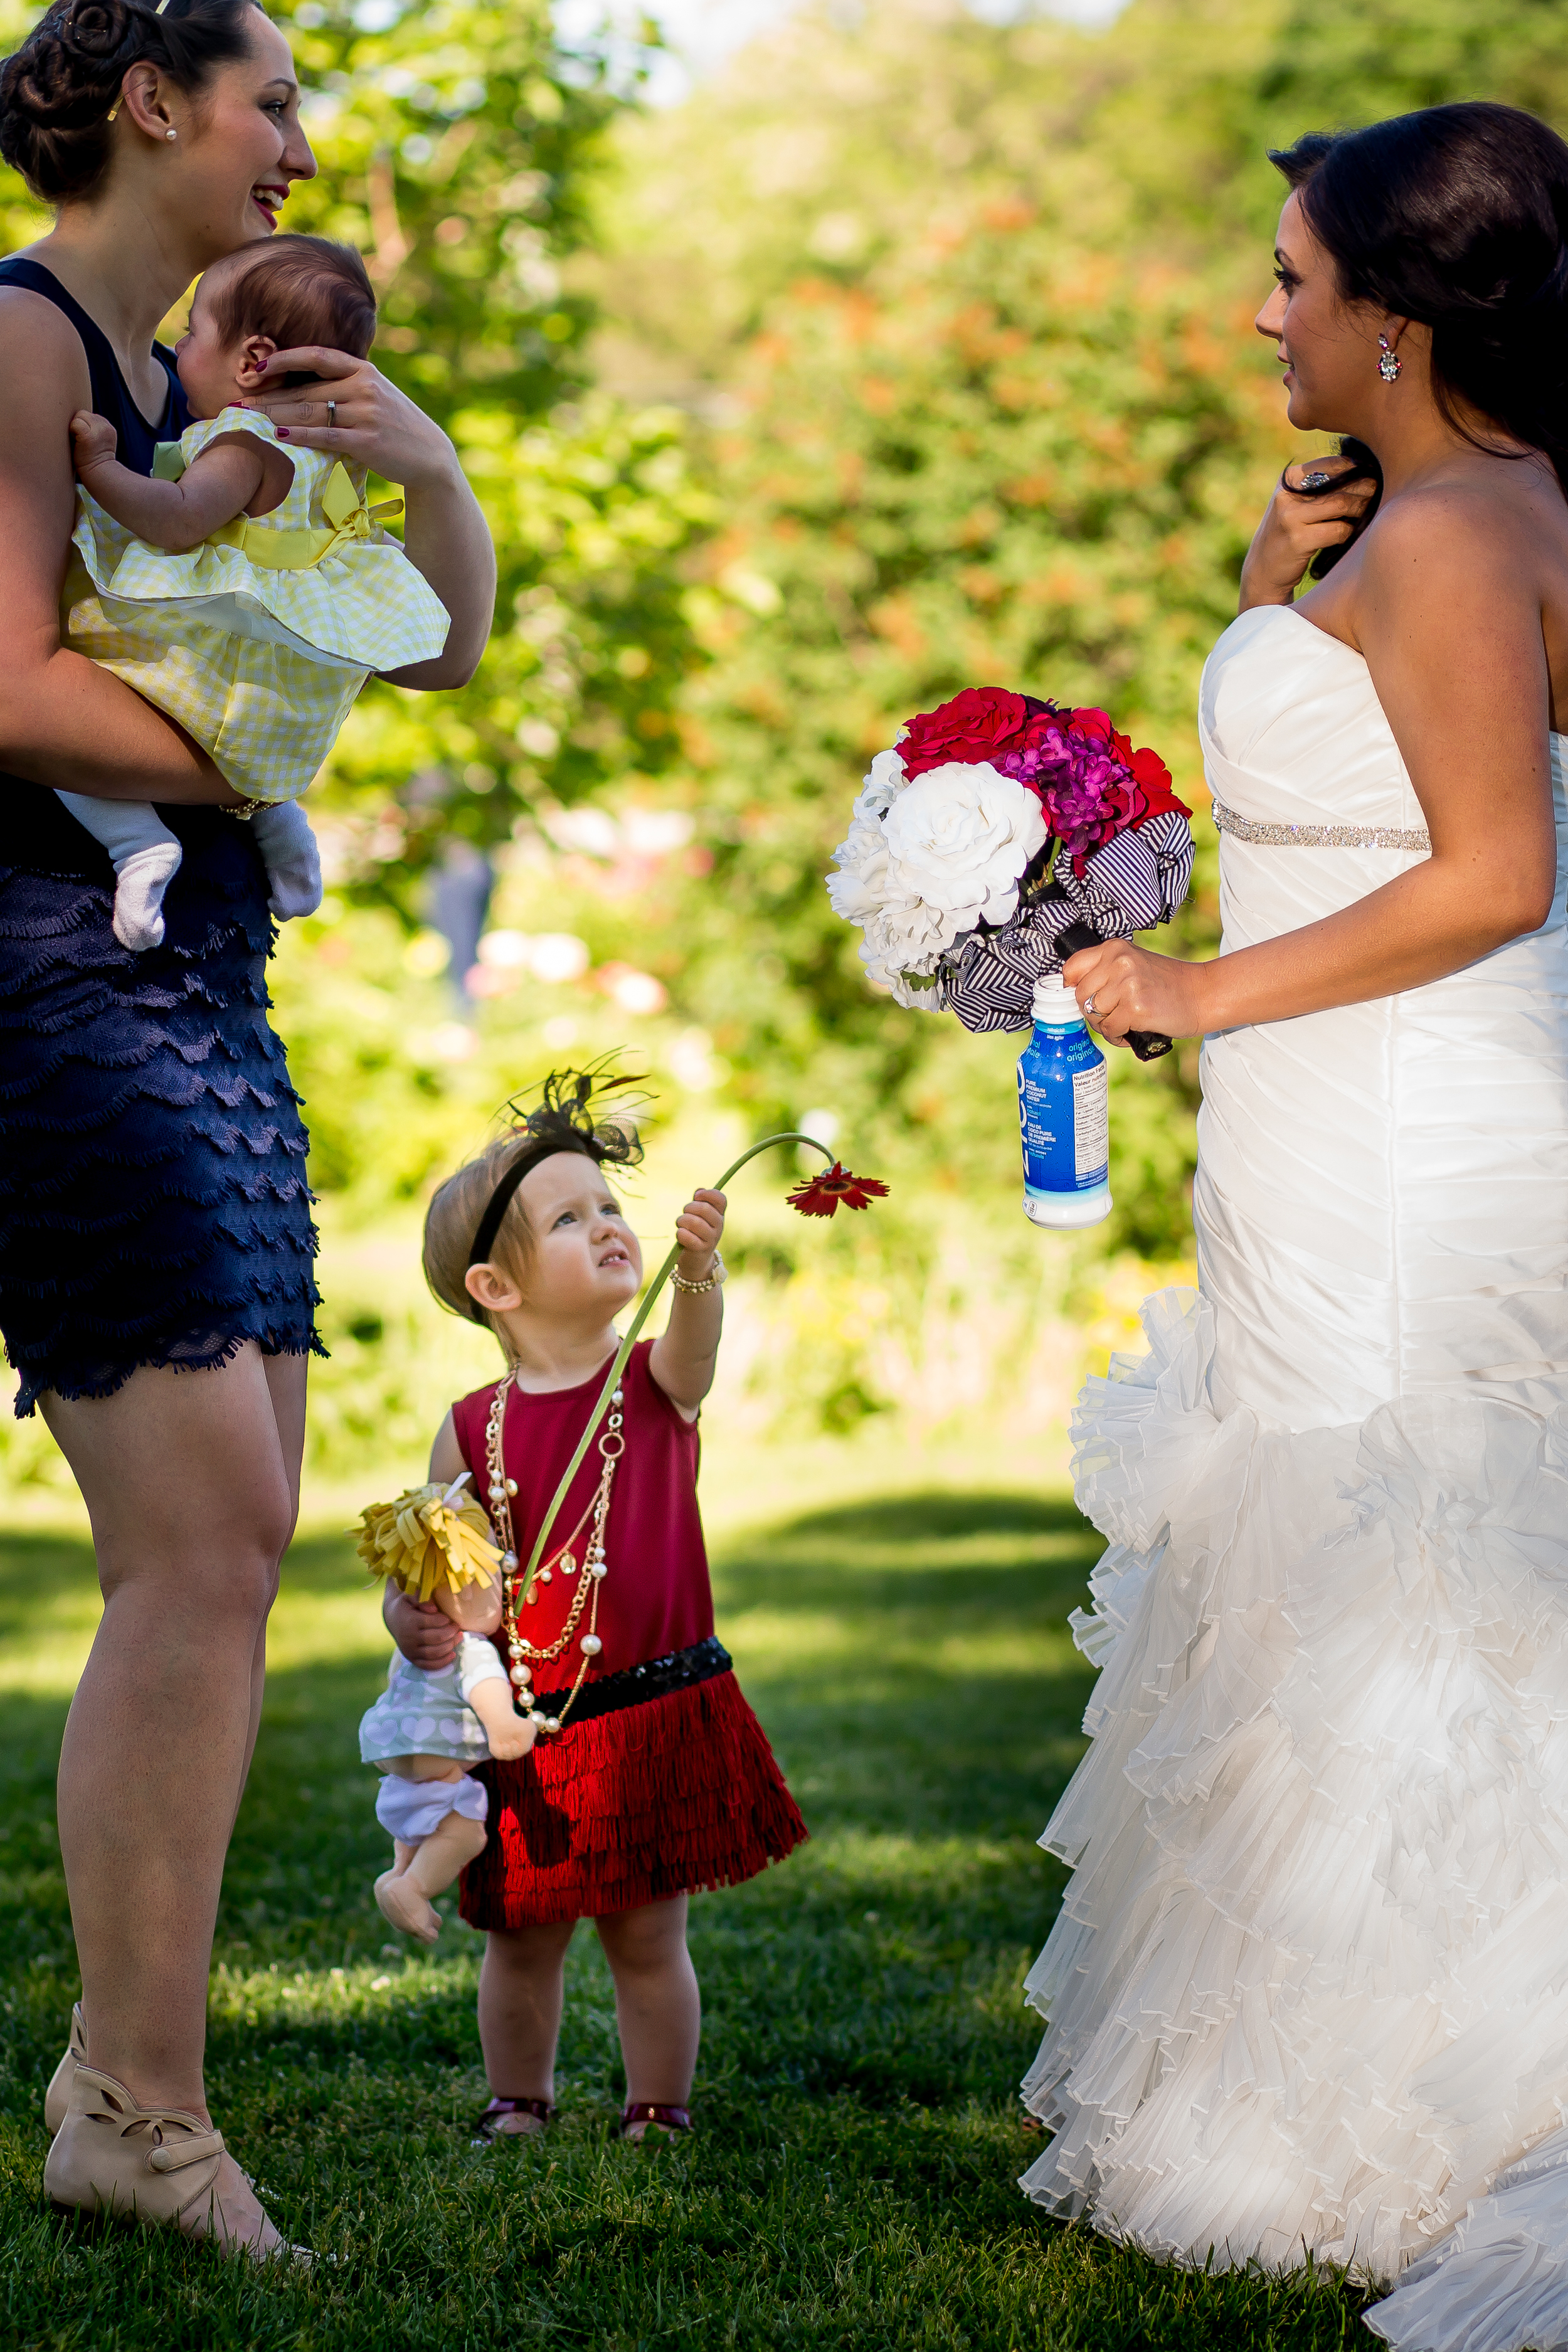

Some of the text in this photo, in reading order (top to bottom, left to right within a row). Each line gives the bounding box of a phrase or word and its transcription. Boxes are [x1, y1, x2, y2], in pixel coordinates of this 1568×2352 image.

[1074, 1064, 1104, 1081] Nutrition Facts
[1025, 1084, 1046, 1093] PREMIUM
[1025, 1089, 1047, 1098] COCONUT
[1026, 1094, 1040, 1103] WATER
